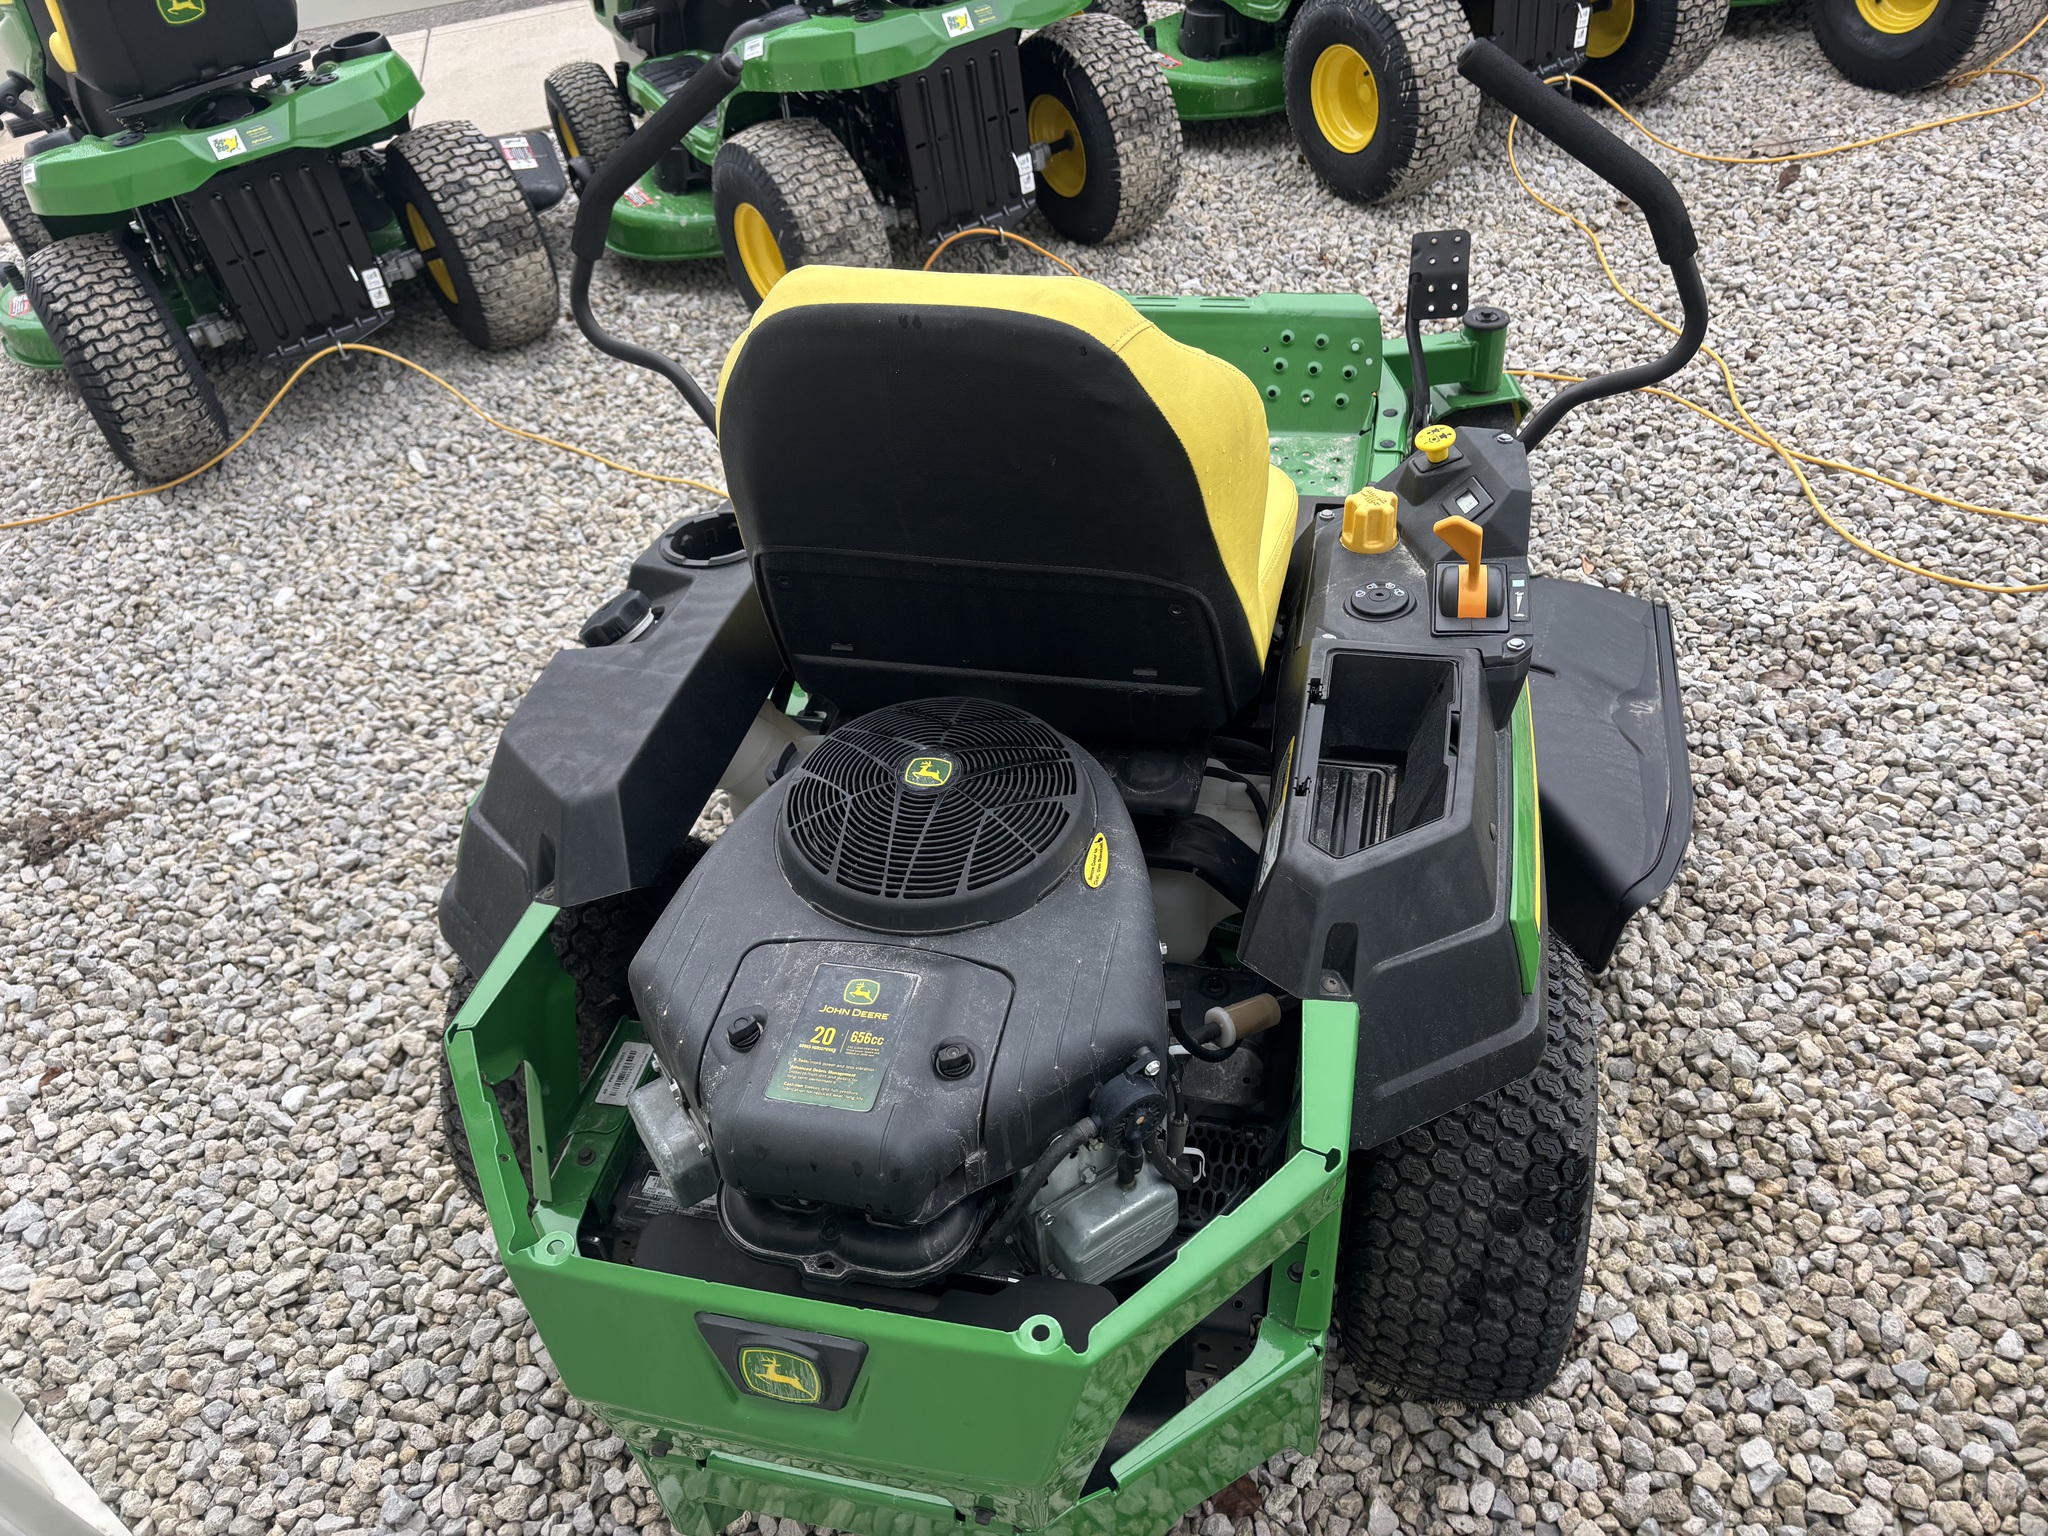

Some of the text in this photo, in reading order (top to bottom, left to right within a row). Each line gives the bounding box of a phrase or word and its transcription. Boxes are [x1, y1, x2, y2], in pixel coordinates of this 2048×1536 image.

[819, 1005, 889, 1020] JOHN DEERE
[810, 1026, 836, 1045] 20
[850, 1030, 885, 1046] 656cc
[828, 1069, 857, 1078] Management
